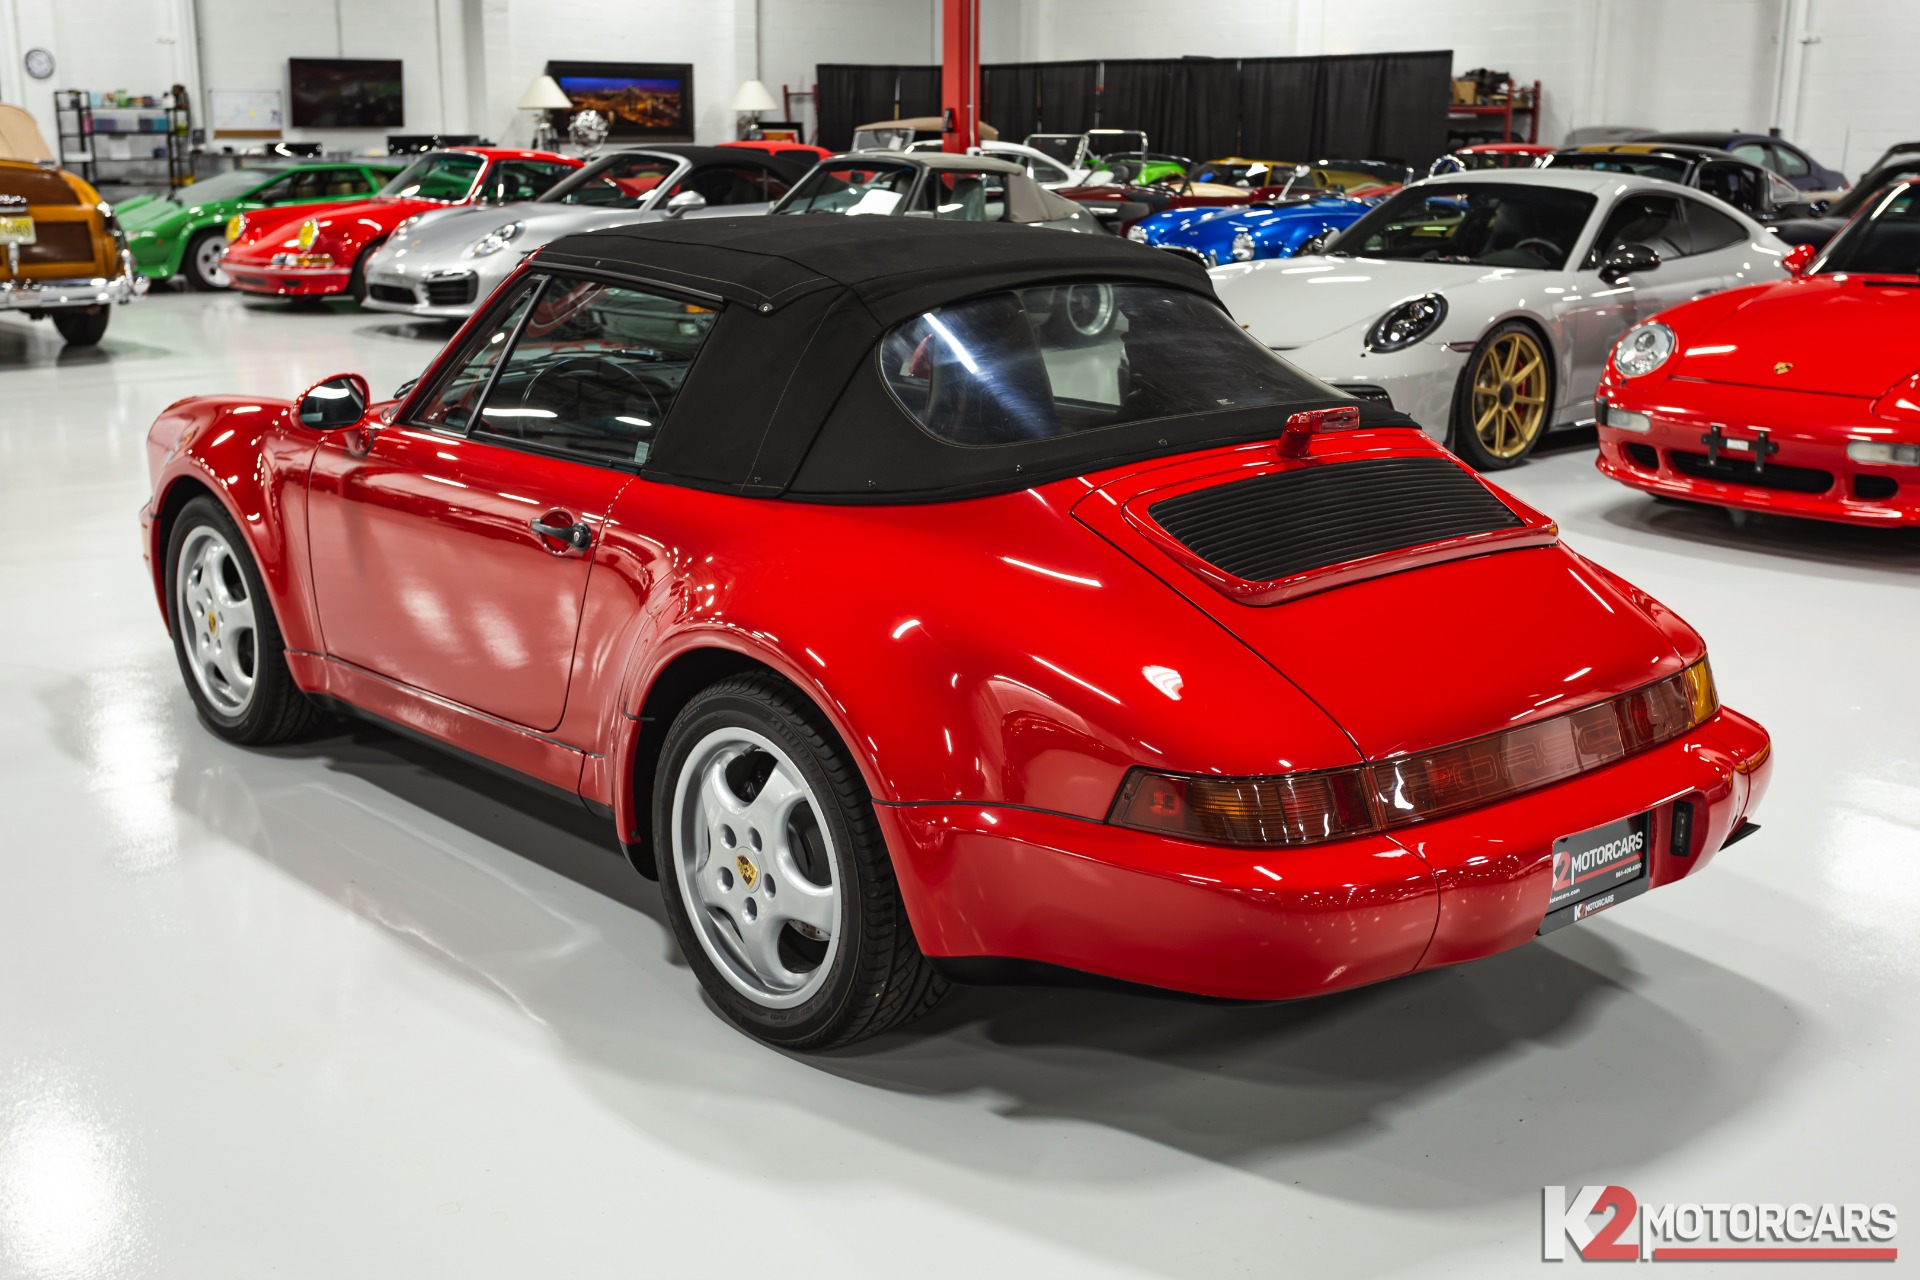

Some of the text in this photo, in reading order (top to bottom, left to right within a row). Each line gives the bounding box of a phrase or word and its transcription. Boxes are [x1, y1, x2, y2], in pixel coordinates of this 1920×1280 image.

[1571, 831, 1644, 886] MOTORCARS
[1549, 888, 1581, 904] otorcars.com
[1574, 894, 1615, 922] K2 MOTORCARS
